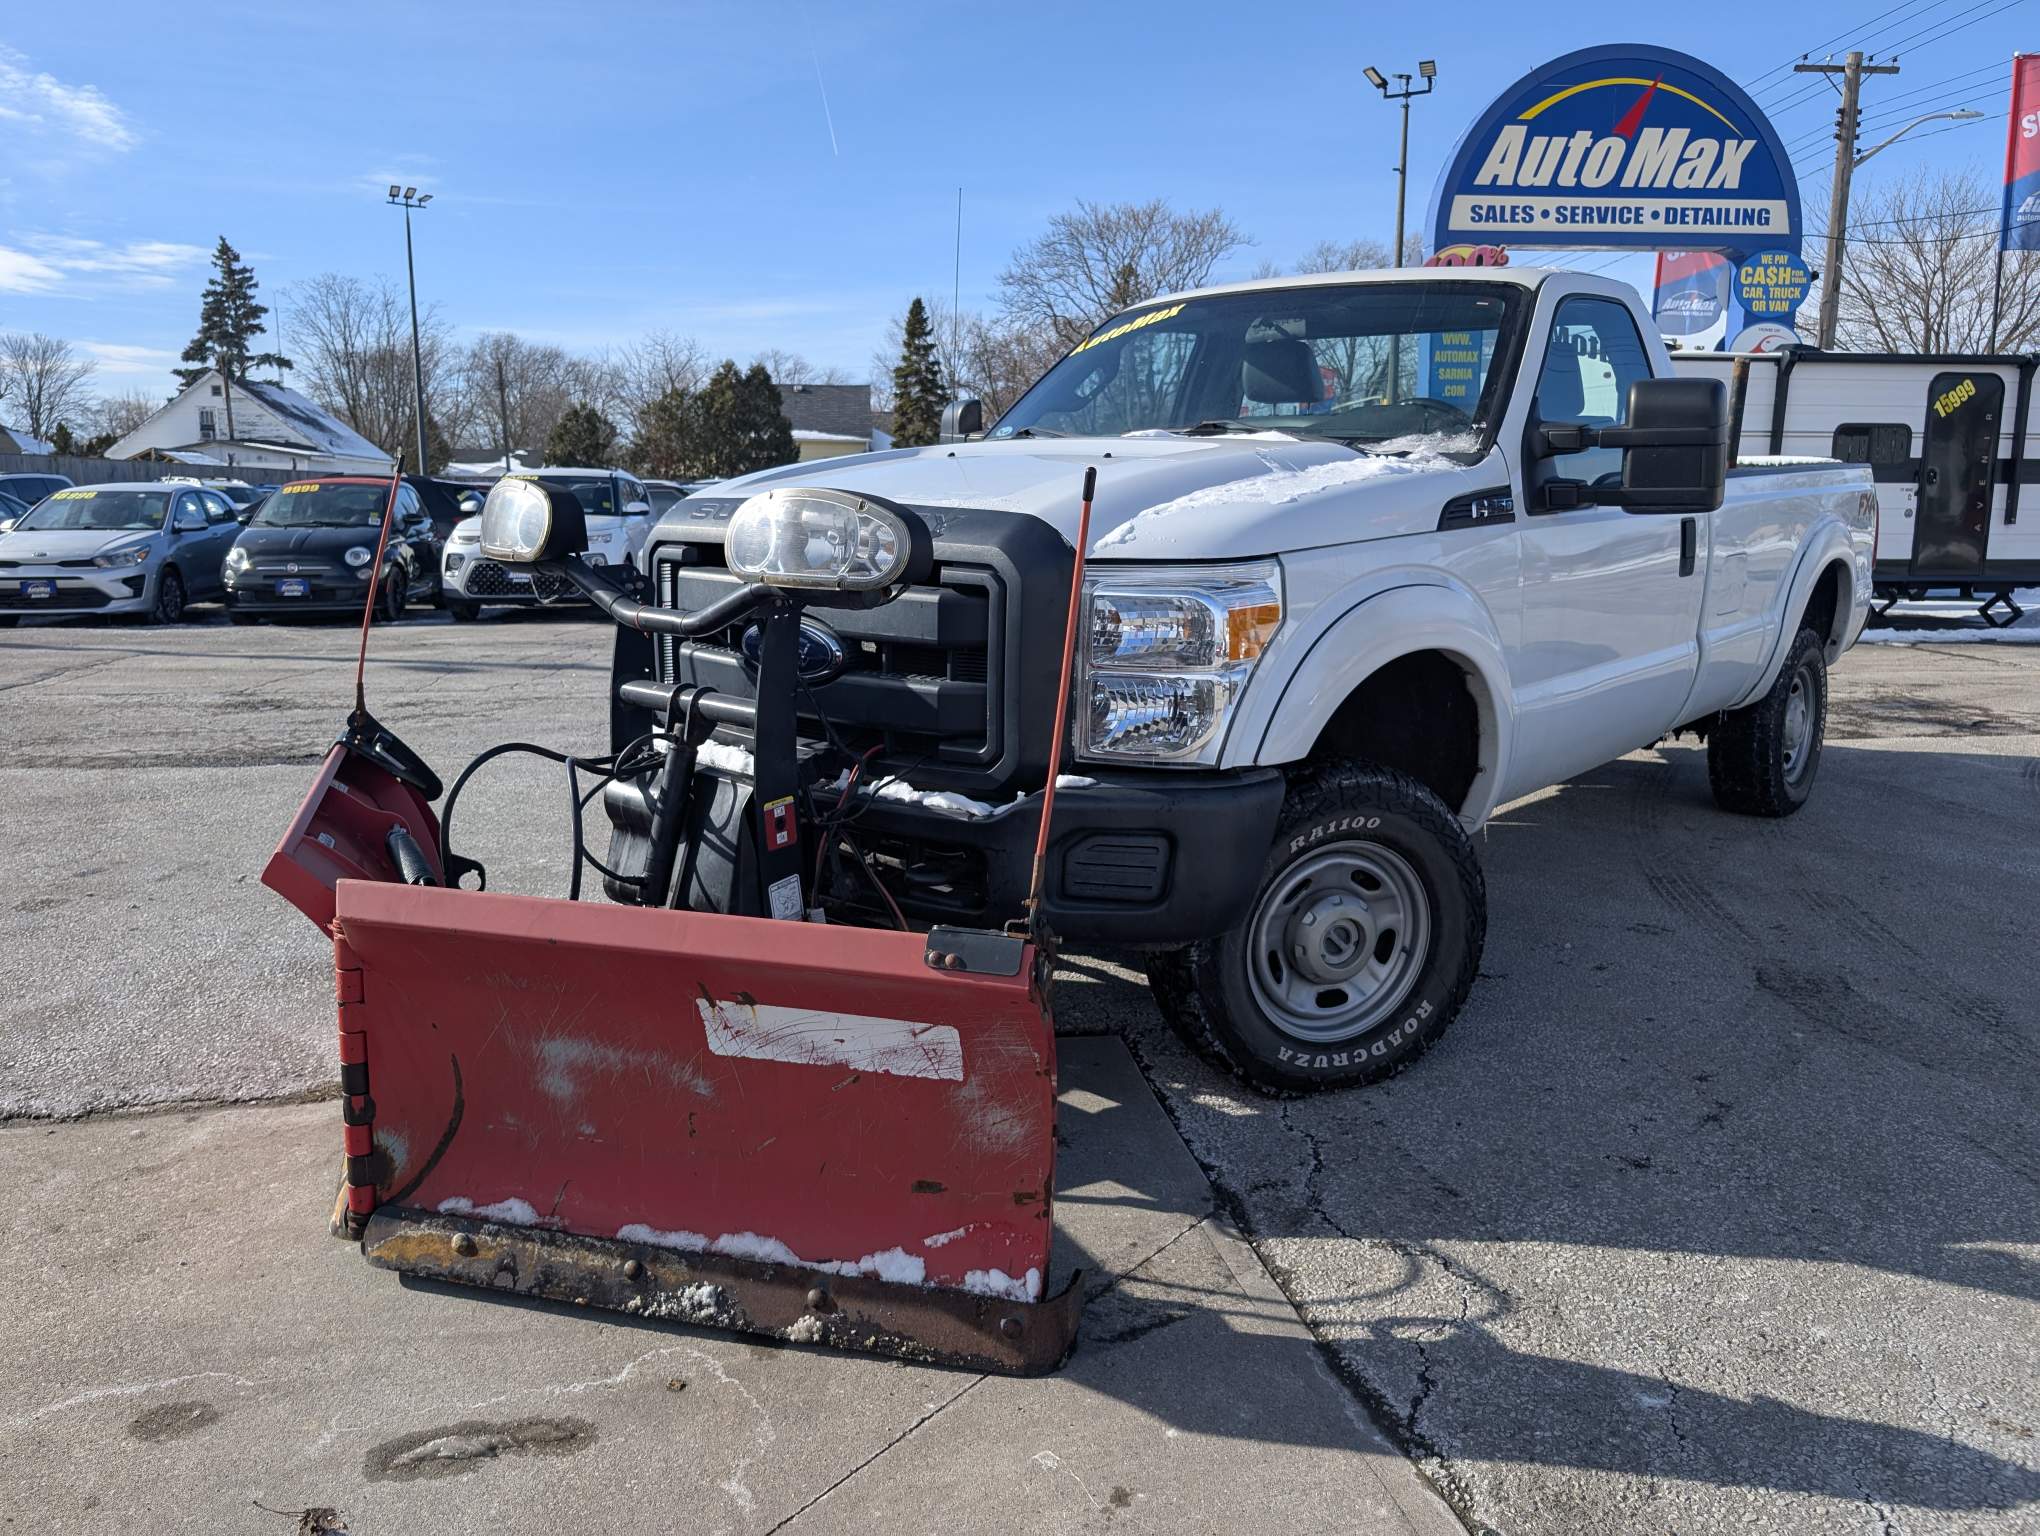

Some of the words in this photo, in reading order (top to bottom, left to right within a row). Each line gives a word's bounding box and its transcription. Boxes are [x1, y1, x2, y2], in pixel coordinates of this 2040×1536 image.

[2022, 110, 2040, 139] S
[1473, 124, 1758, 190] AutoMax
[1470, 204, 1535, 225] SALES
[1554, 205, 1645, 226] SERVICE
[1663, 206, 1771, 227] DETAILING
[1761, 254, 1773, 265] WE
[1774, 254, 1788, 265] PAY
[1740, 266, 1791, 287] CA$H
[1742, 287, 1766, 300] CAR,
[1769, 286, 1801, 299] TRUCK
[1752, 300, 1766, 312] OR
[1768, 300, 1789, 312] VAN
[1442, 332, 1472, 346] WWW.
[1434, 350, 1479, 364] AUTOMAX
[1438, 368, 1473, 380] SARNIA
[1441, 384, 1466, 397] .COM
[1932, 378, 1977, 419] 15999
[1288, 815, 1382, 855] RA1100
